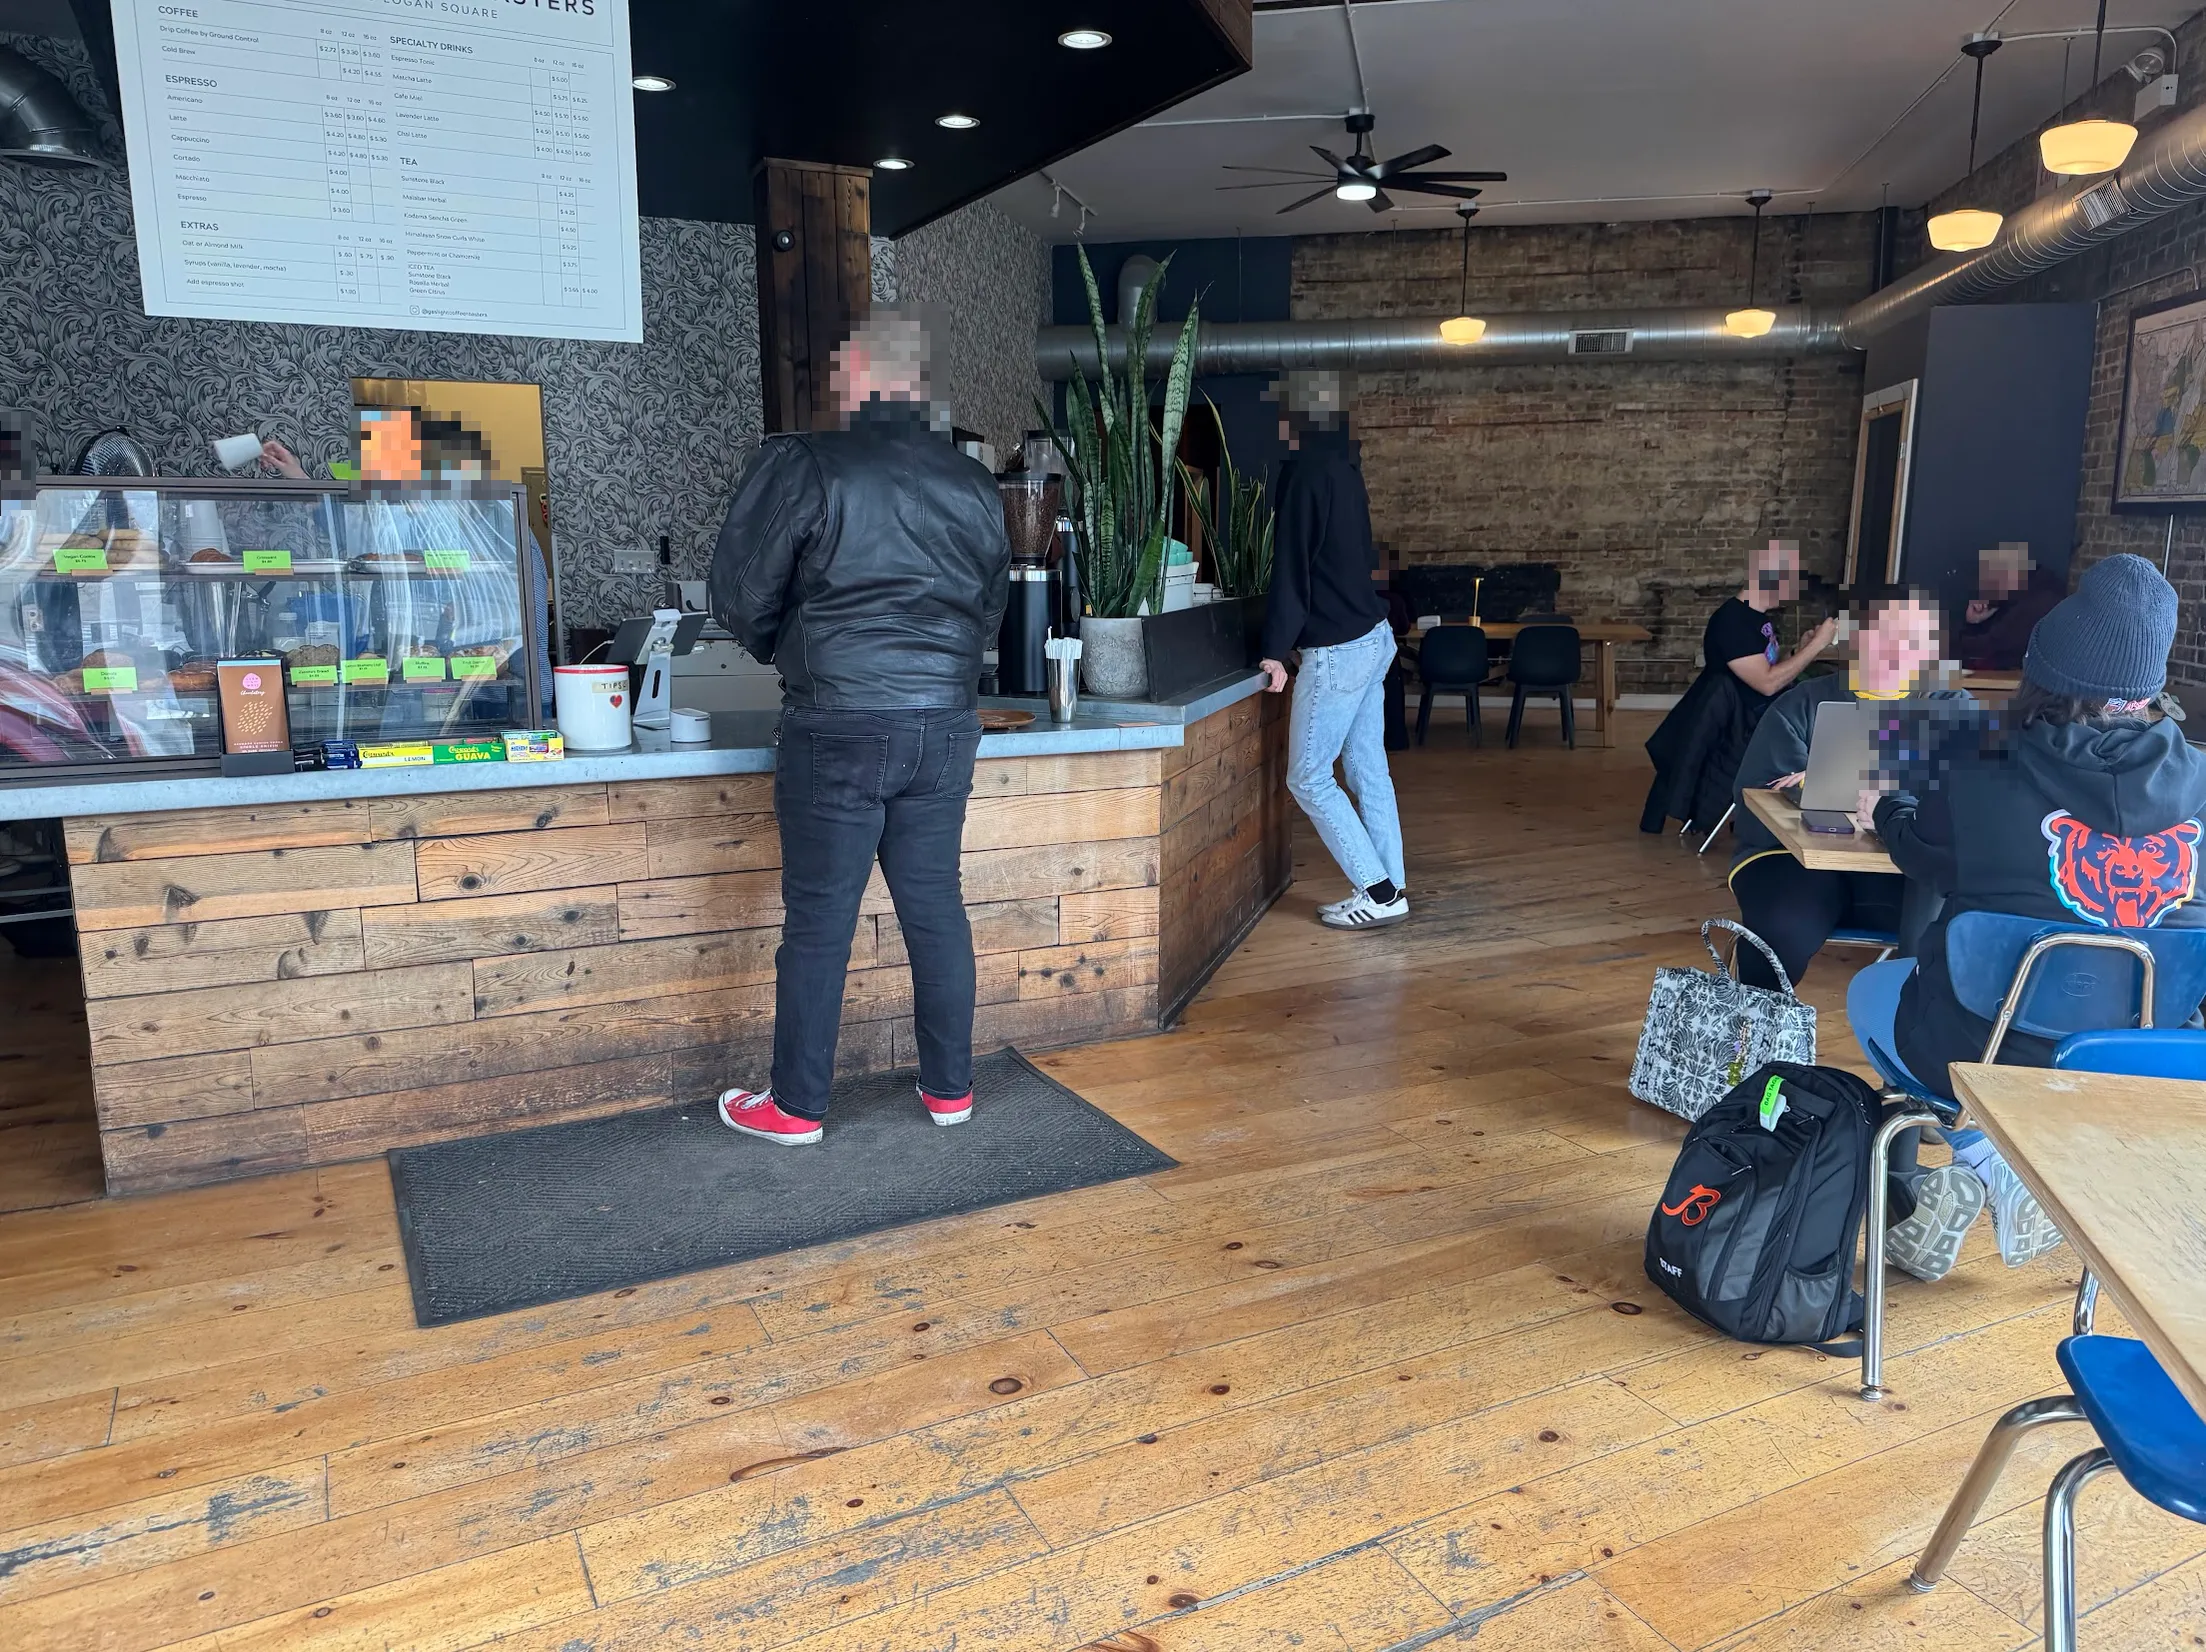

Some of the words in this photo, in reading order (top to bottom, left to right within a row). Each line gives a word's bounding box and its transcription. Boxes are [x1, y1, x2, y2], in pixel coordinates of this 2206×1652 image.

[158, 5, 198, 18] COFFEE
[440, 2, 498, 19] SQUARE
[160, 25, 174, 34] Drip
[176, 27, 199, 36] Coffee
[200, 30, 208, 38] by
[209, 31, 233, 40] Ground
[234, 34, 259, 43] Control
[161, 45, 177, 53] Cold
[179, 47, 195, 55] Brew
[389, 36, 438, 49] SPECIALTY
[440, 42, 473, 54] DRINKS
[391, 54, 418, 63] Espresso
[419, 58, 435, 66] Tonic
[165, 74, 217, 88] ESPRESSO
[393, 74, 415, 82] Matcha
[167, 94, 203, 103] Americano
[169, 114, 187, 122] Latte
[396, 112, 423, 120] Lavender
[171, 134, 210, 144] Cappuccino
[173, 154, 200, 162] Cortado
[399, 156, 418, 166] TEA
[175, 174, 209, 182] Macchiato
[177, 193, 207, 201] Espresso
[180, 220, 219, 231] EXTRAS
[182, 239, 194, 247] Oat
[204, 241, 228, 249] Almond
[184, 259, 206, 267] Syrups
[455, 752, 491, 761] GUAVA
[1659, 1257, 1683, 1278] STAFF
